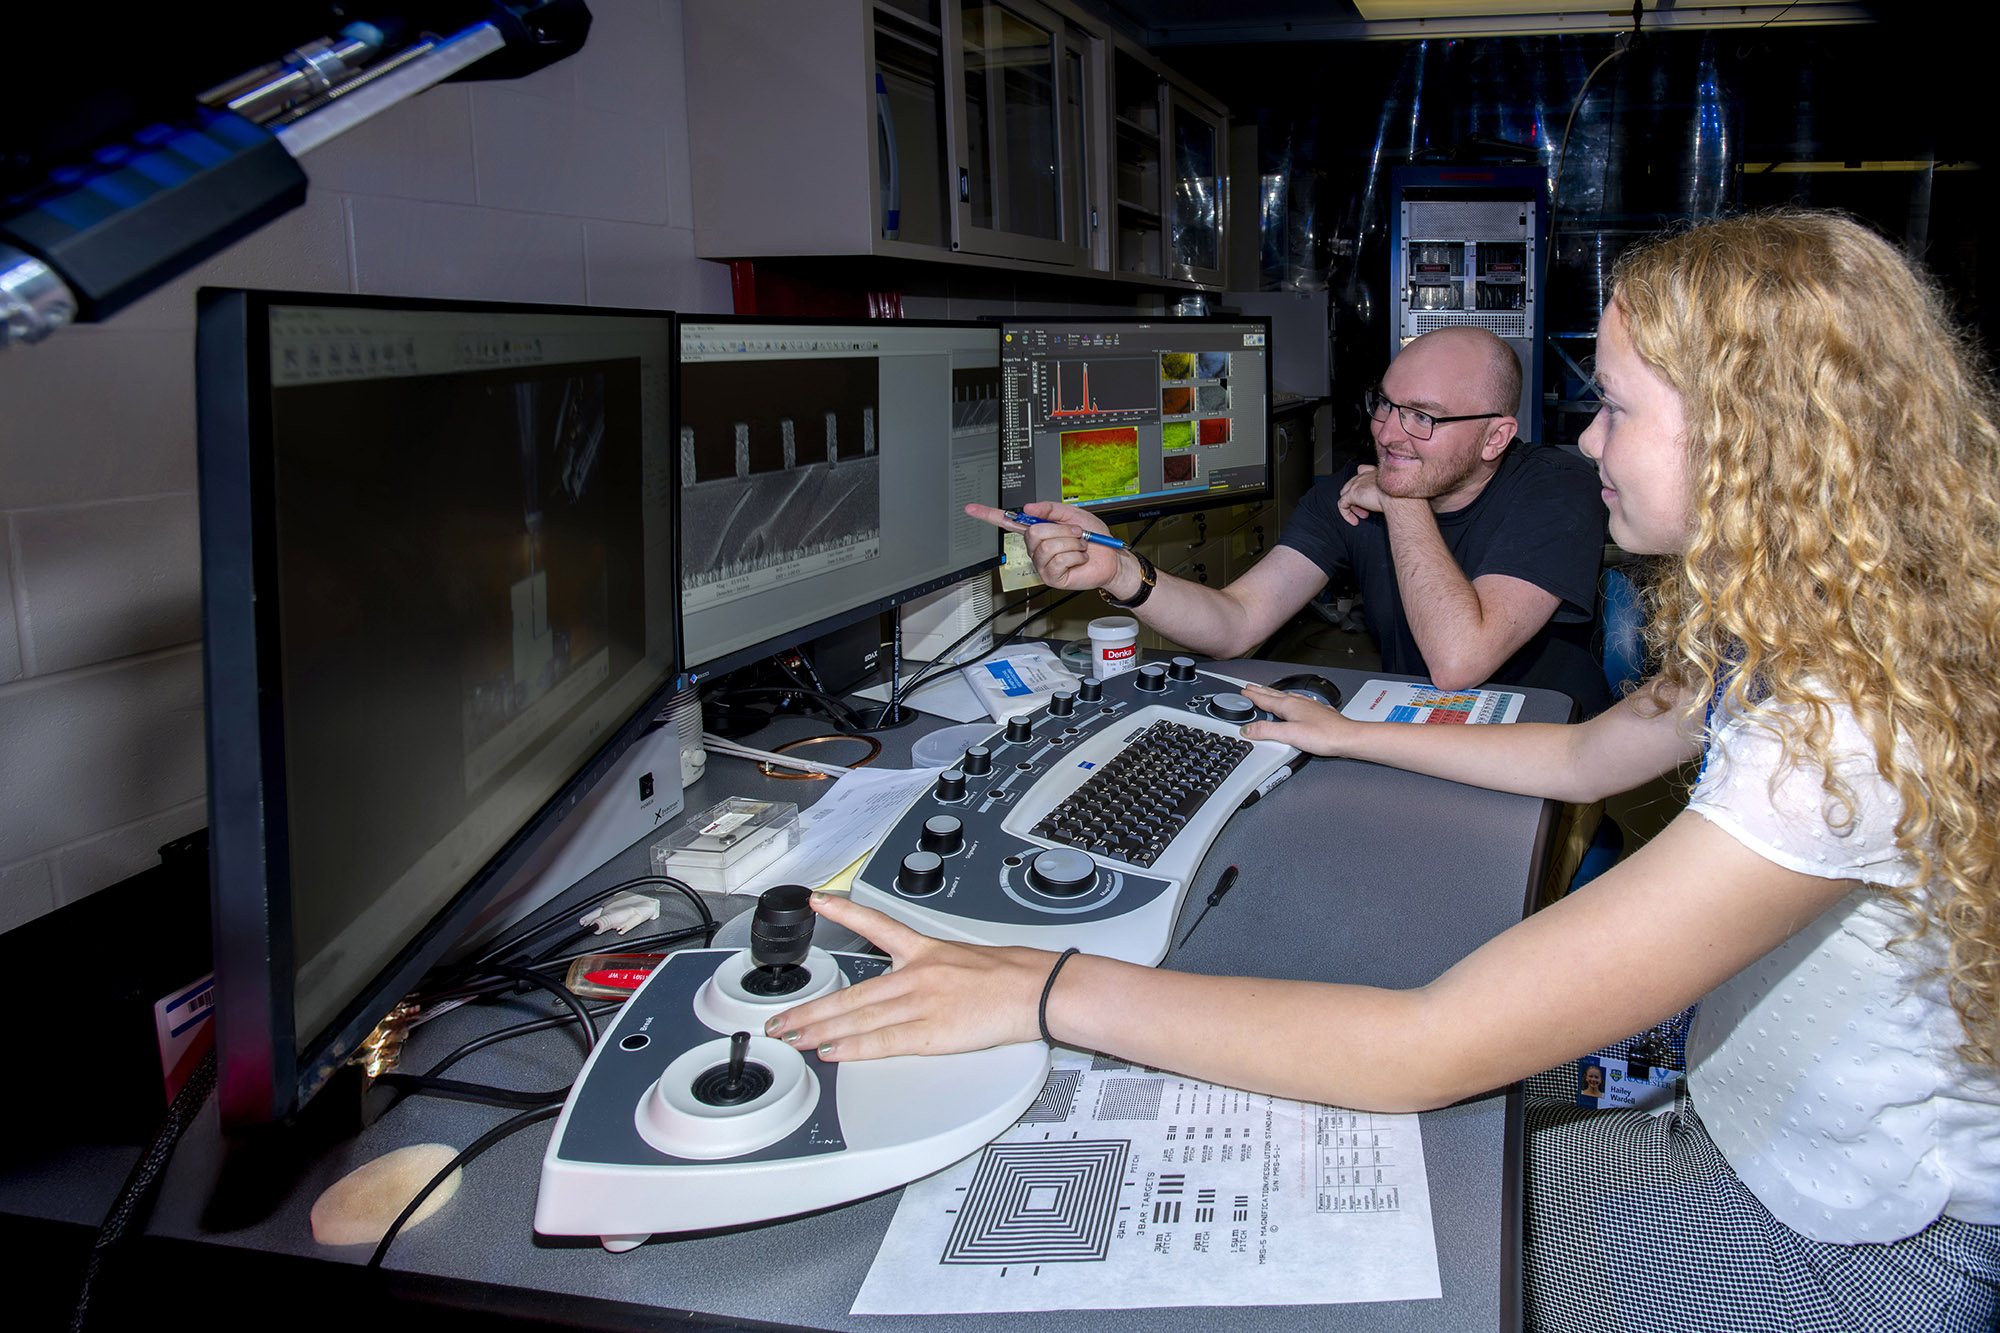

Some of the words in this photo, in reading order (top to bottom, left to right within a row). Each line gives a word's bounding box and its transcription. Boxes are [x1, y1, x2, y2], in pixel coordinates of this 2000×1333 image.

[864, 650, 878, 662] EDAX
[1108, 649, 1132, 658] Denka
[1610, 1094, 1636, 1104] Wardell
[1611, 1086, 1631, 1097] Hailey
[1130, 1155, 1140, 1173] PITCH
[1142, 1172, 1155, 1209] TARGETS
[1260, 1147, 1271, 1236] MAGNIFICATION/RESOLUTION
[1162, 1232, 1172, 1254] PITCH
[1201, 1232, 1210, 1253] PITCH
[1259, 1240, 1267, 1264] MRS-5
